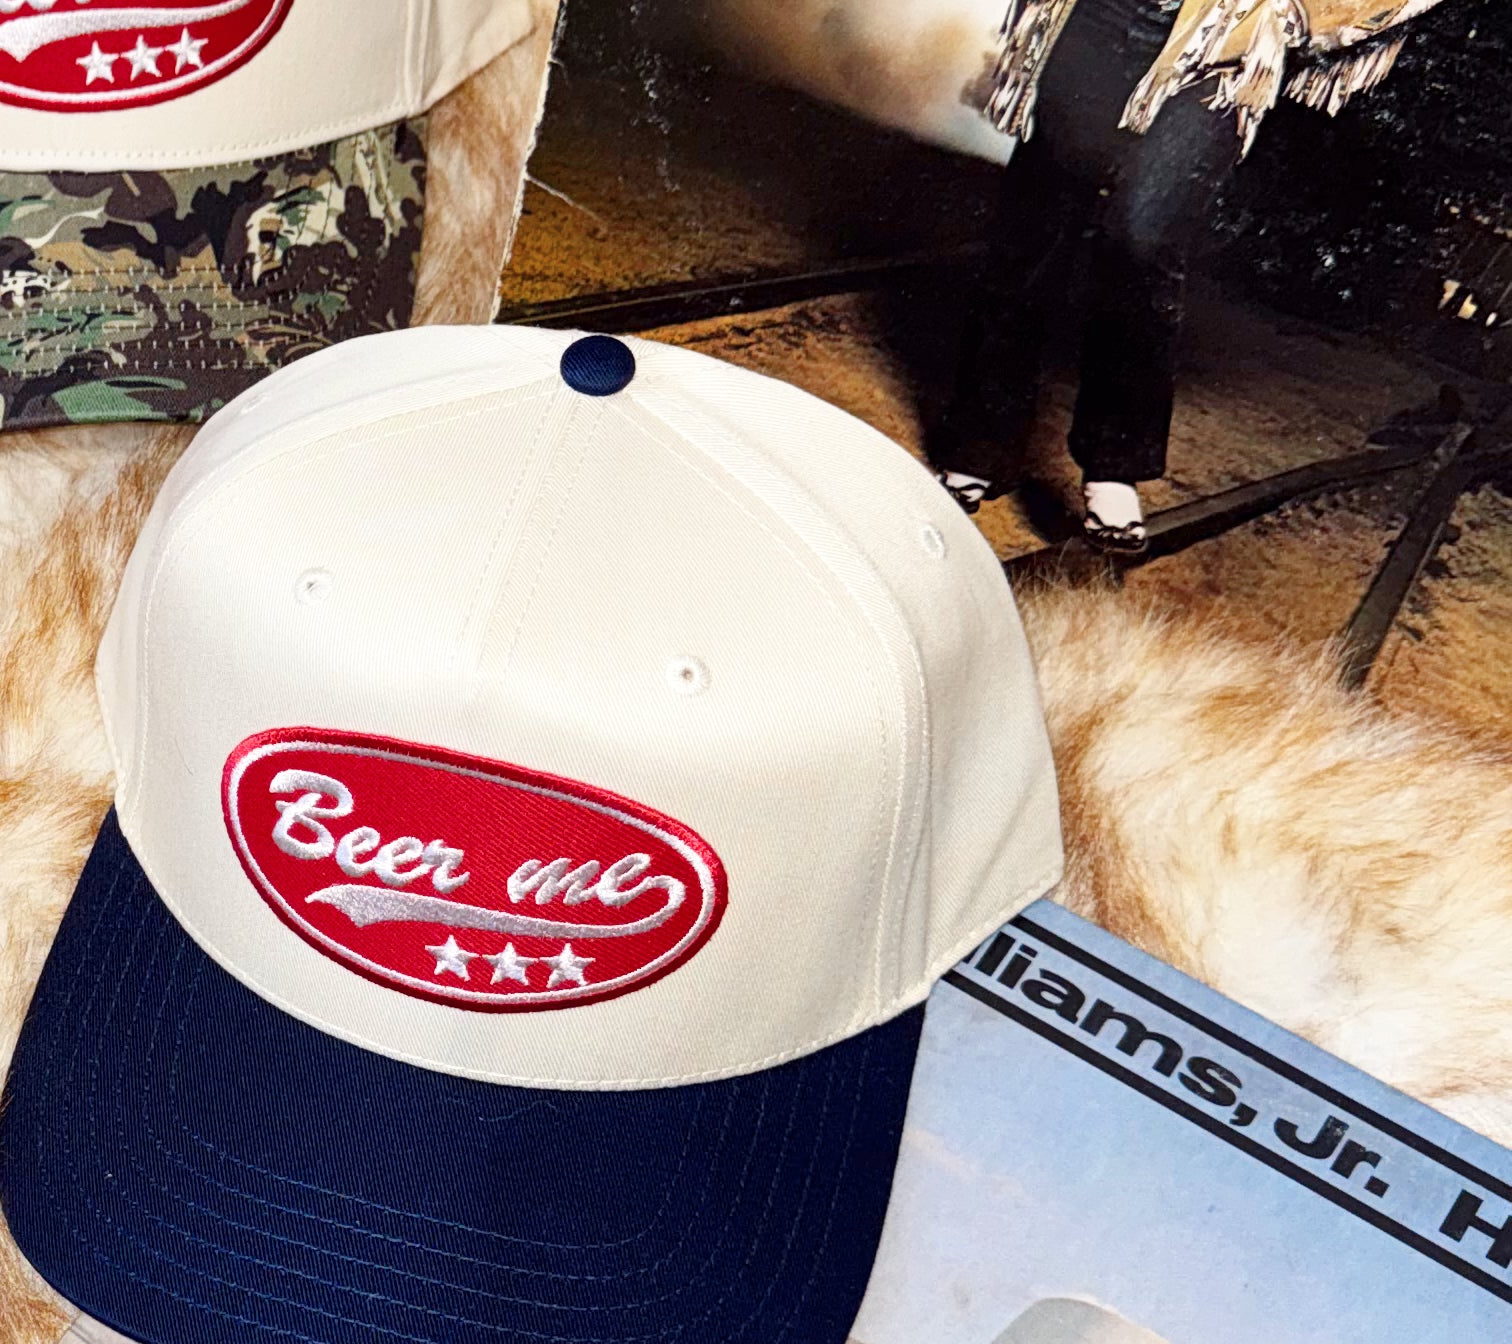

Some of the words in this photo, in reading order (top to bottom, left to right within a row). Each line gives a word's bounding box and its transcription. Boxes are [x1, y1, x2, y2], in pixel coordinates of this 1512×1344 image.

[268, 768, 470, 894] Beer
[507, 852, 668, 907] me
[962, 931, 1259, 1127] liams,
[1273, 1114, 1390, 1199] Jr.
